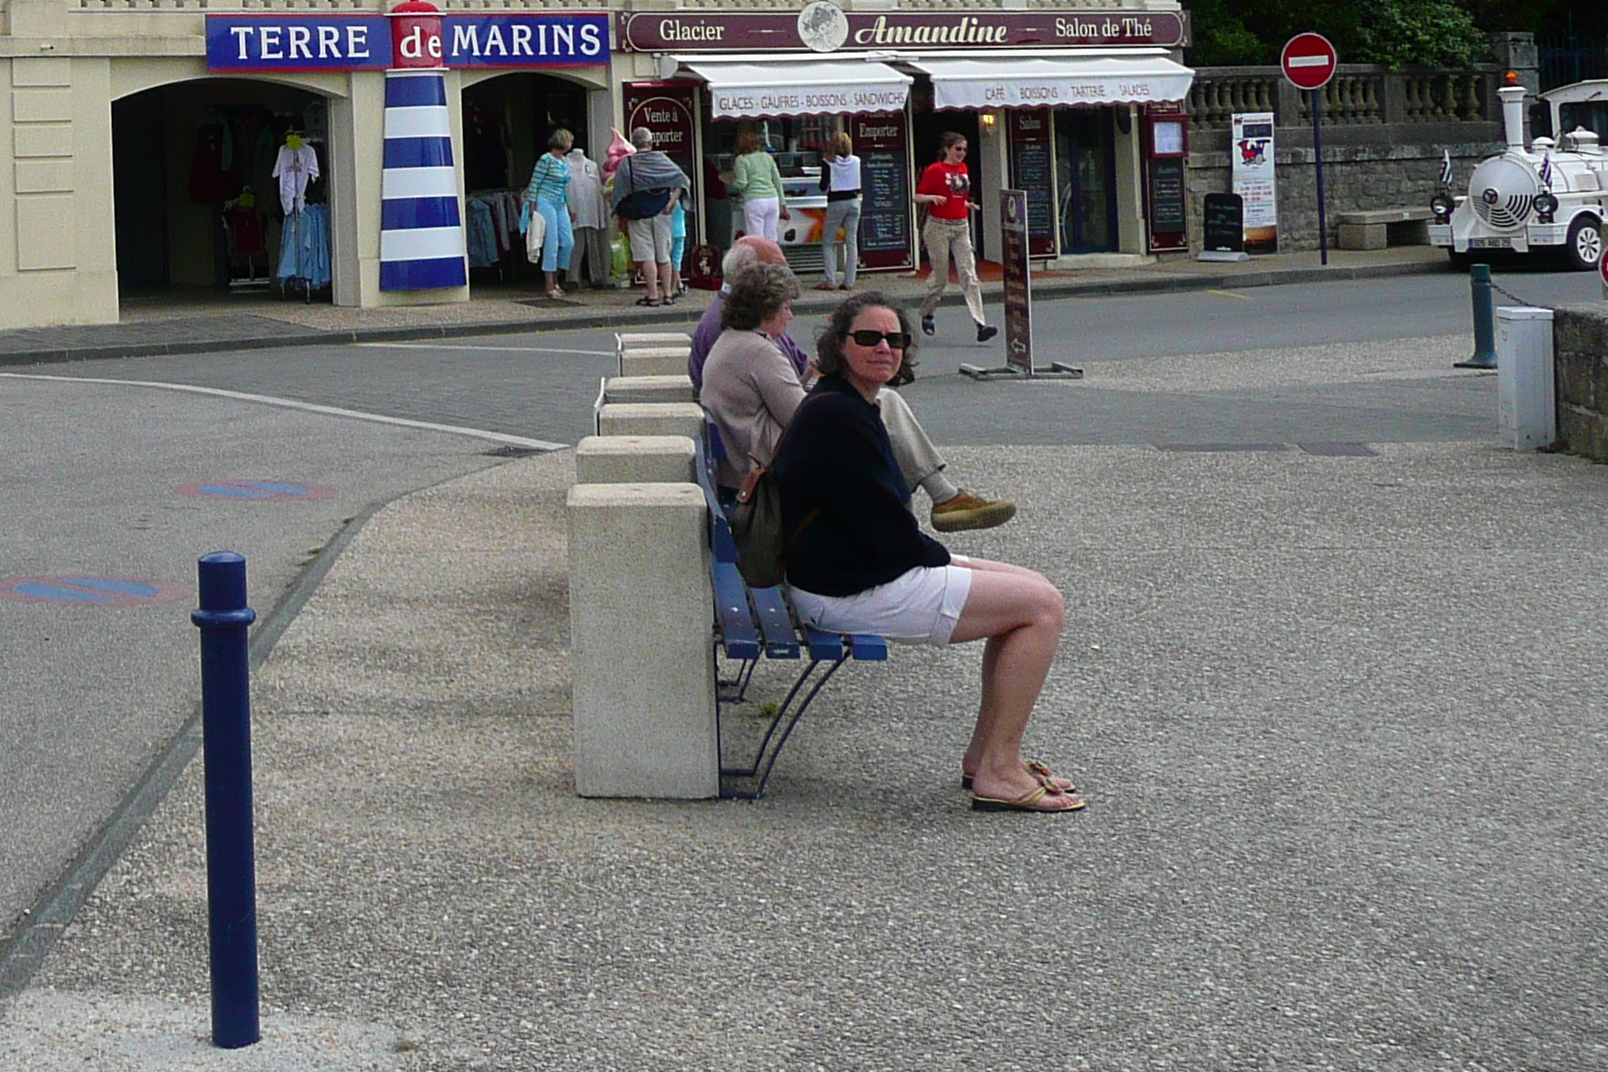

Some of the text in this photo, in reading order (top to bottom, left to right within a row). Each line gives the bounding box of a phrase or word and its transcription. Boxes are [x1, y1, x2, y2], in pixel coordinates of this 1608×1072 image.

[659, 15, 1153, 44] Glacier Amandine Salon de Thé
[230, 24, 601, 60] TERRE de MARINS
[719, 90, 905, 111] GLACES GAUFRES BOISSONS SANDWICHS
[985, 83, 1150, 101] CAFÉ BOISSONS TARTERIE SALADES
[643, 107, 671, 123] Vente
[1019, 115, 1041, 129] Salon
[859, 122, 899, 141] Emporter
